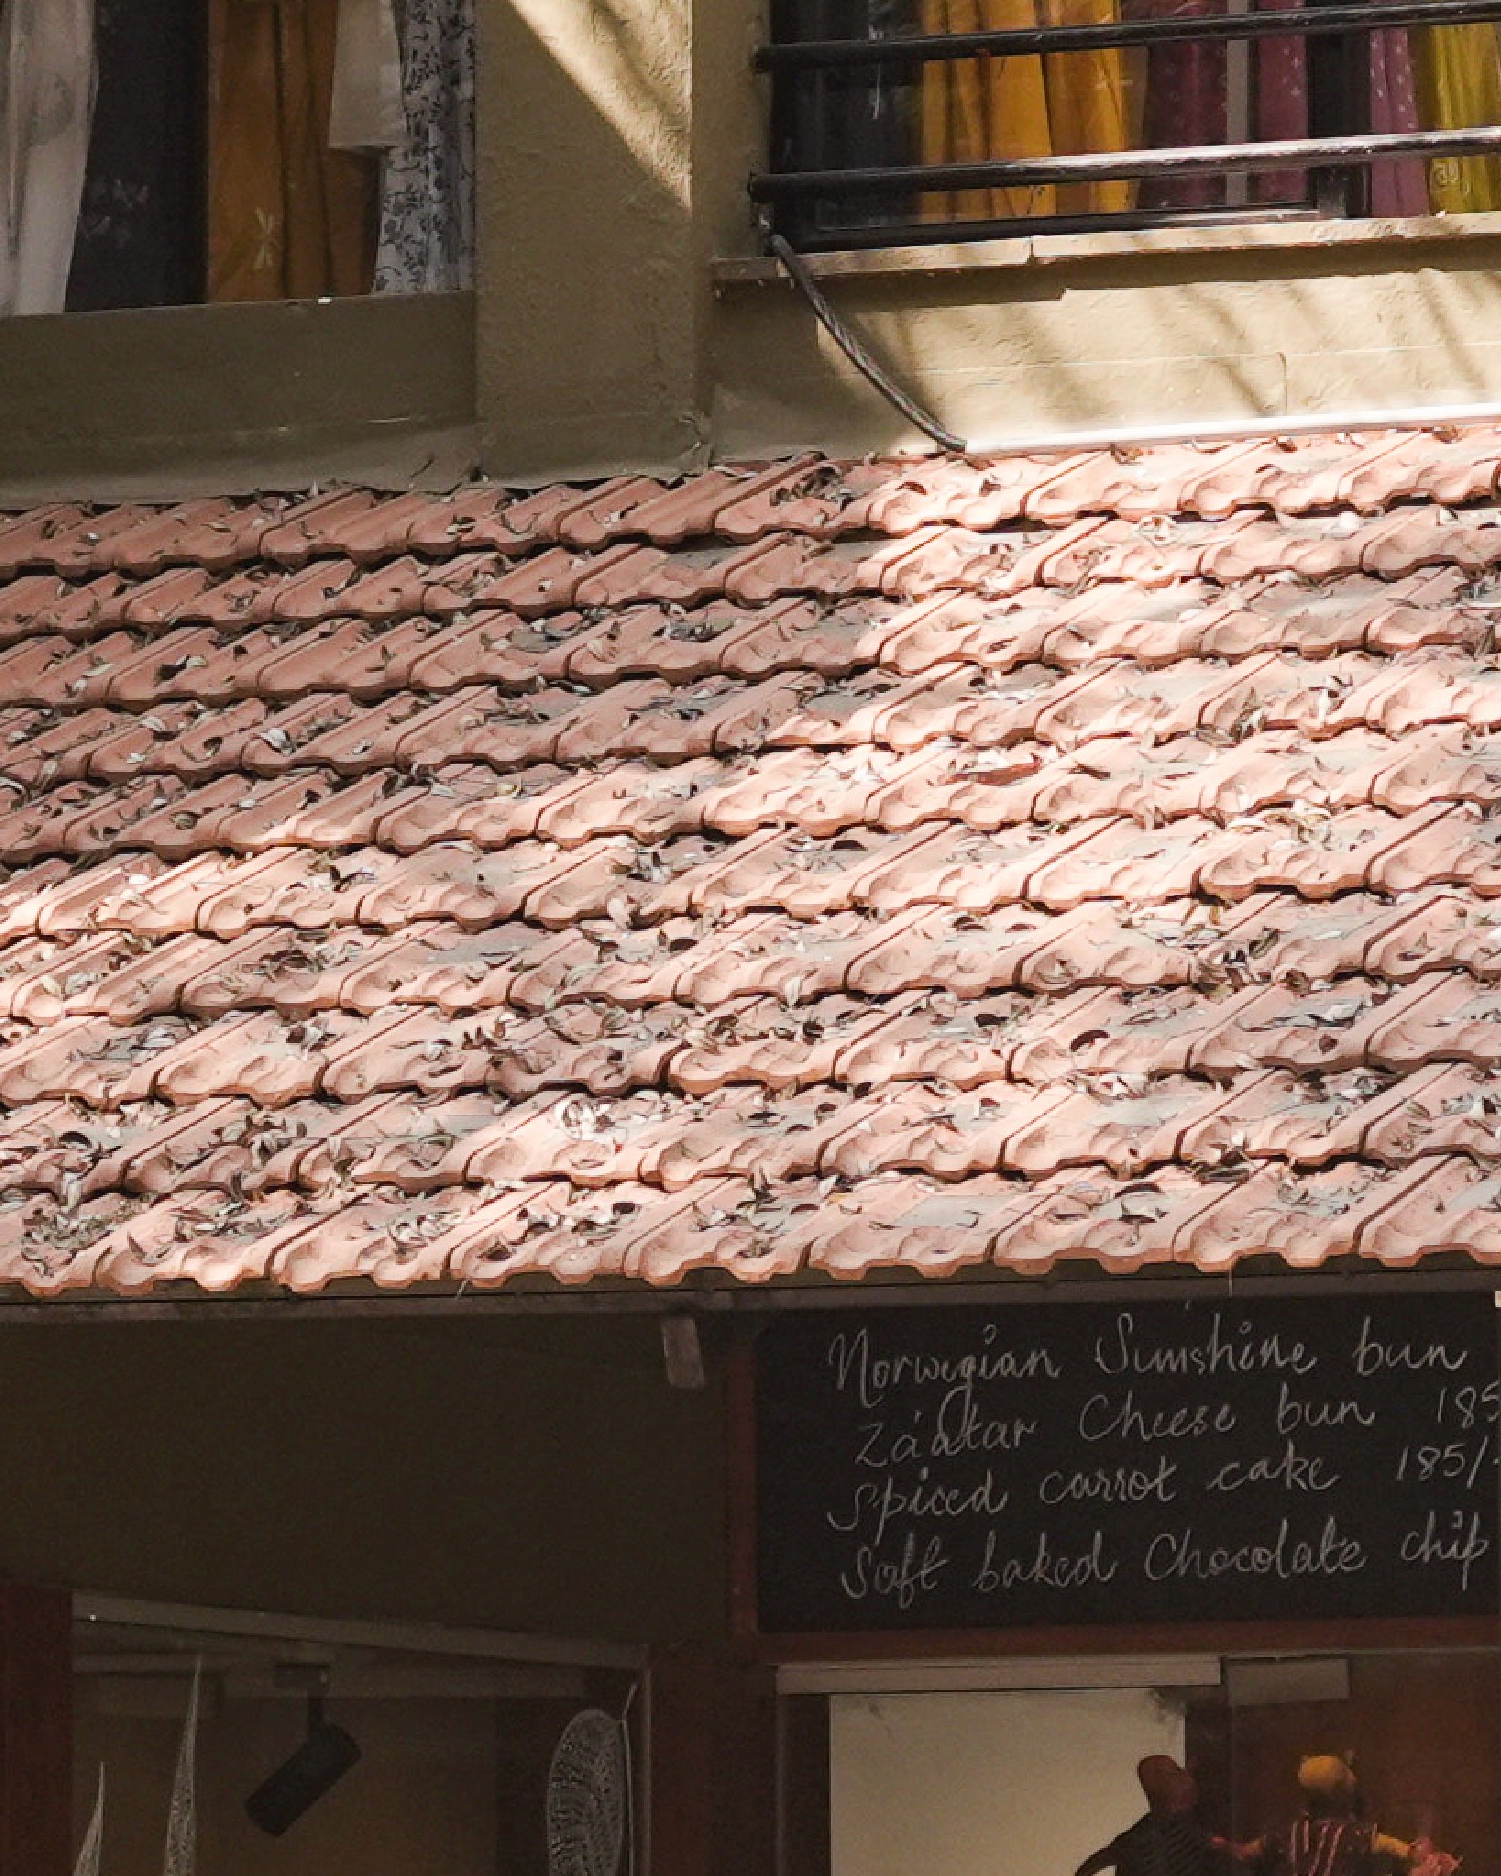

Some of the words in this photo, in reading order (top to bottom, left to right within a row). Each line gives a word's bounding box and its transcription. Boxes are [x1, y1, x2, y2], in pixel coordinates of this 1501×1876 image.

[1352, 1316, 1467, 1376] bun
[1079, 1389, 1236, 1441] Cheese
[1278, 1382, 1375, 1435] bun
[1039, 1455, 1178, 1504] carrot
[1206, 1440, 1341, 1491] cake
[841, 1532, 949, 1608] Soft
[973, 1529, 1119, 1593] baked
[1145, 1516, 1367, 1582] Chocolate
[1401, 1510, 1490, 1591] chip
